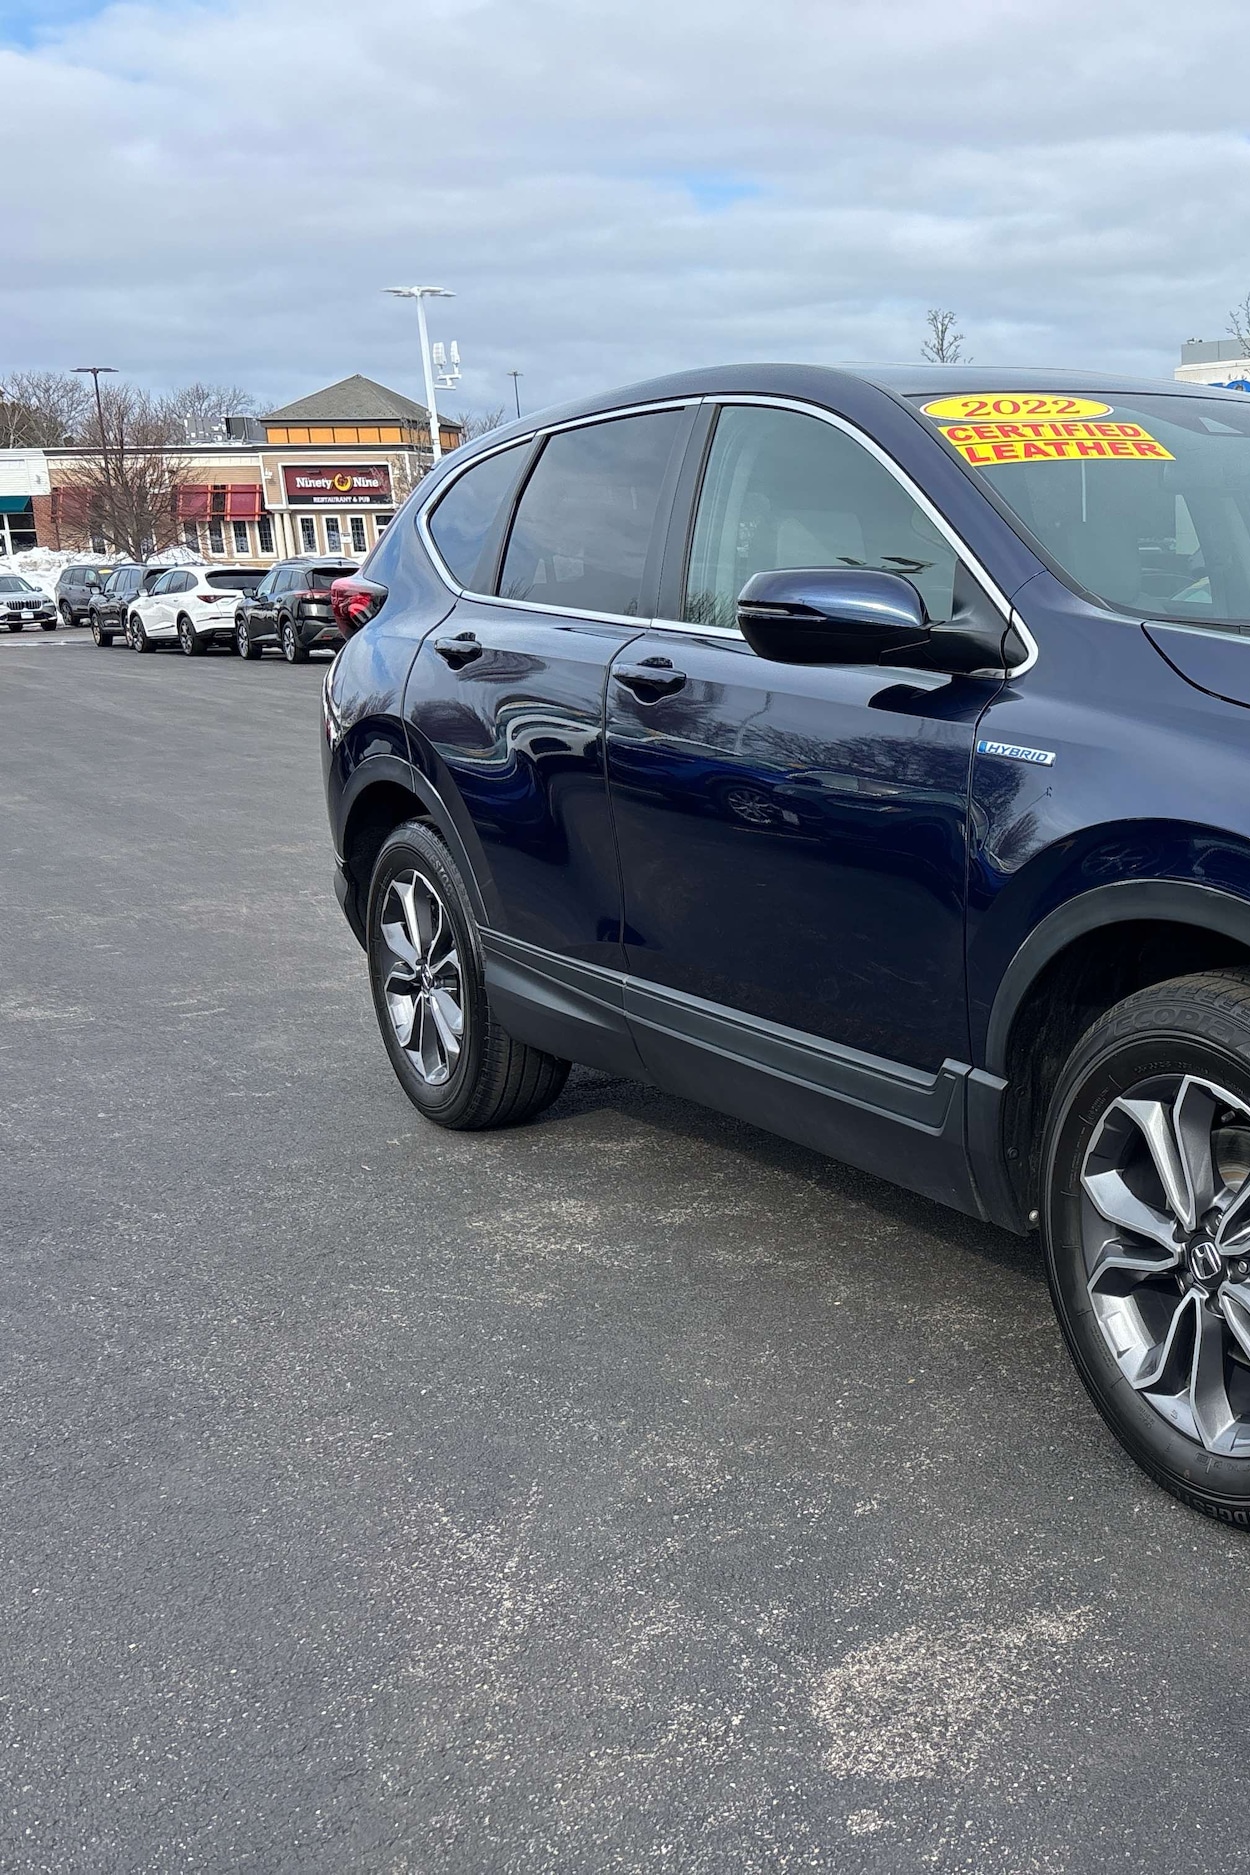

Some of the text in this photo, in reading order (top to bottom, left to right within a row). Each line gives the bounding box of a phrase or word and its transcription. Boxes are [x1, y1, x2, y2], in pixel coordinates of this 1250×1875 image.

[961, 398, 1081, 417] 2022
[946, 423, 1143, 442] CERTIFIED
[965, 441, 1166, 463] LEATHER
[295, 477, 379, 490] Ninety Nine
[987, 743, 1049, 762] HYBRID
